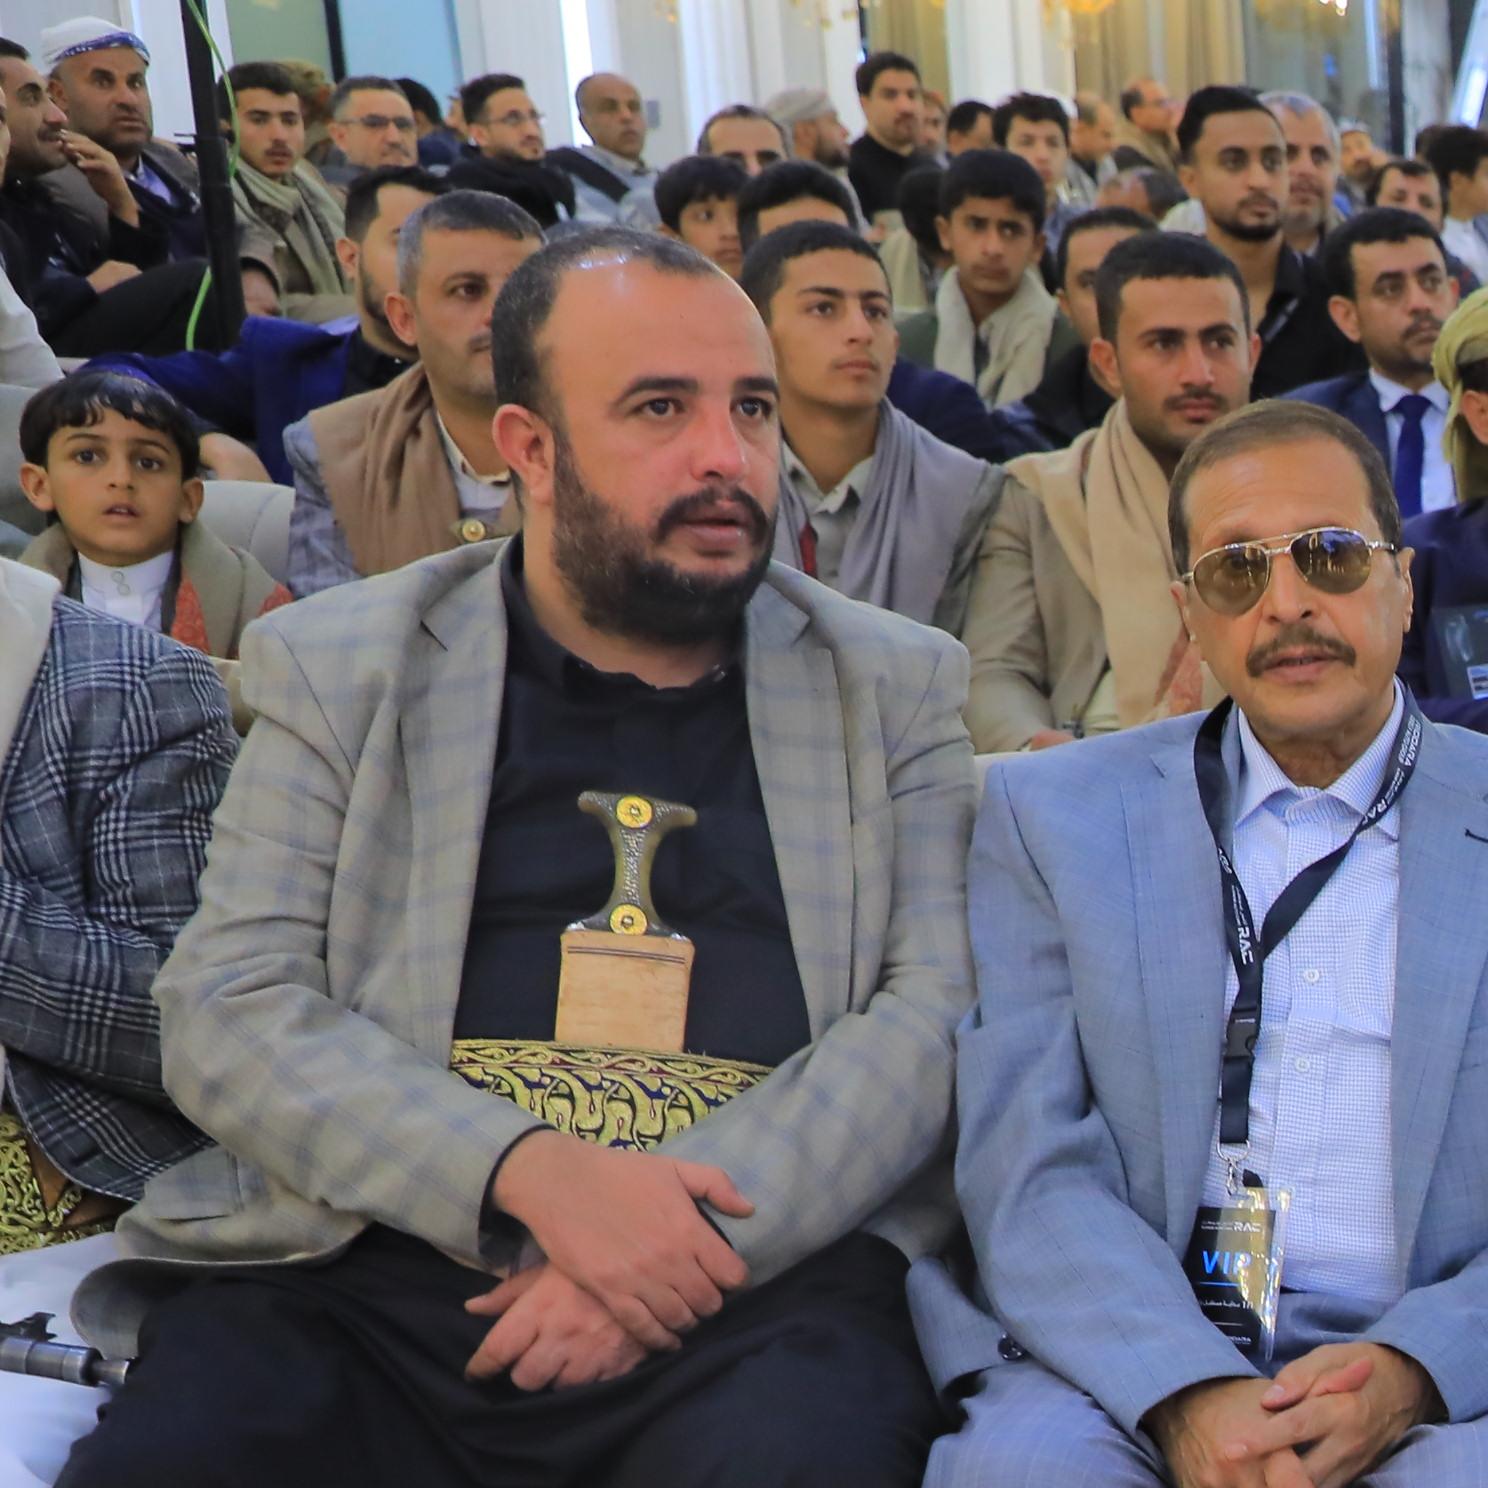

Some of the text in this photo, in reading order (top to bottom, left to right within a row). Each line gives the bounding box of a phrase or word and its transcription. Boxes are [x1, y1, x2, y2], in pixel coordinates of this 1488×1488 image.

[1404, 719, 1421, 766] RIDDARA
[1238, 926, 1254, 966] RAC
[1234, 1221, 1262, 1233] RAC
[1203, 1251, 1252, 1275] VIP
